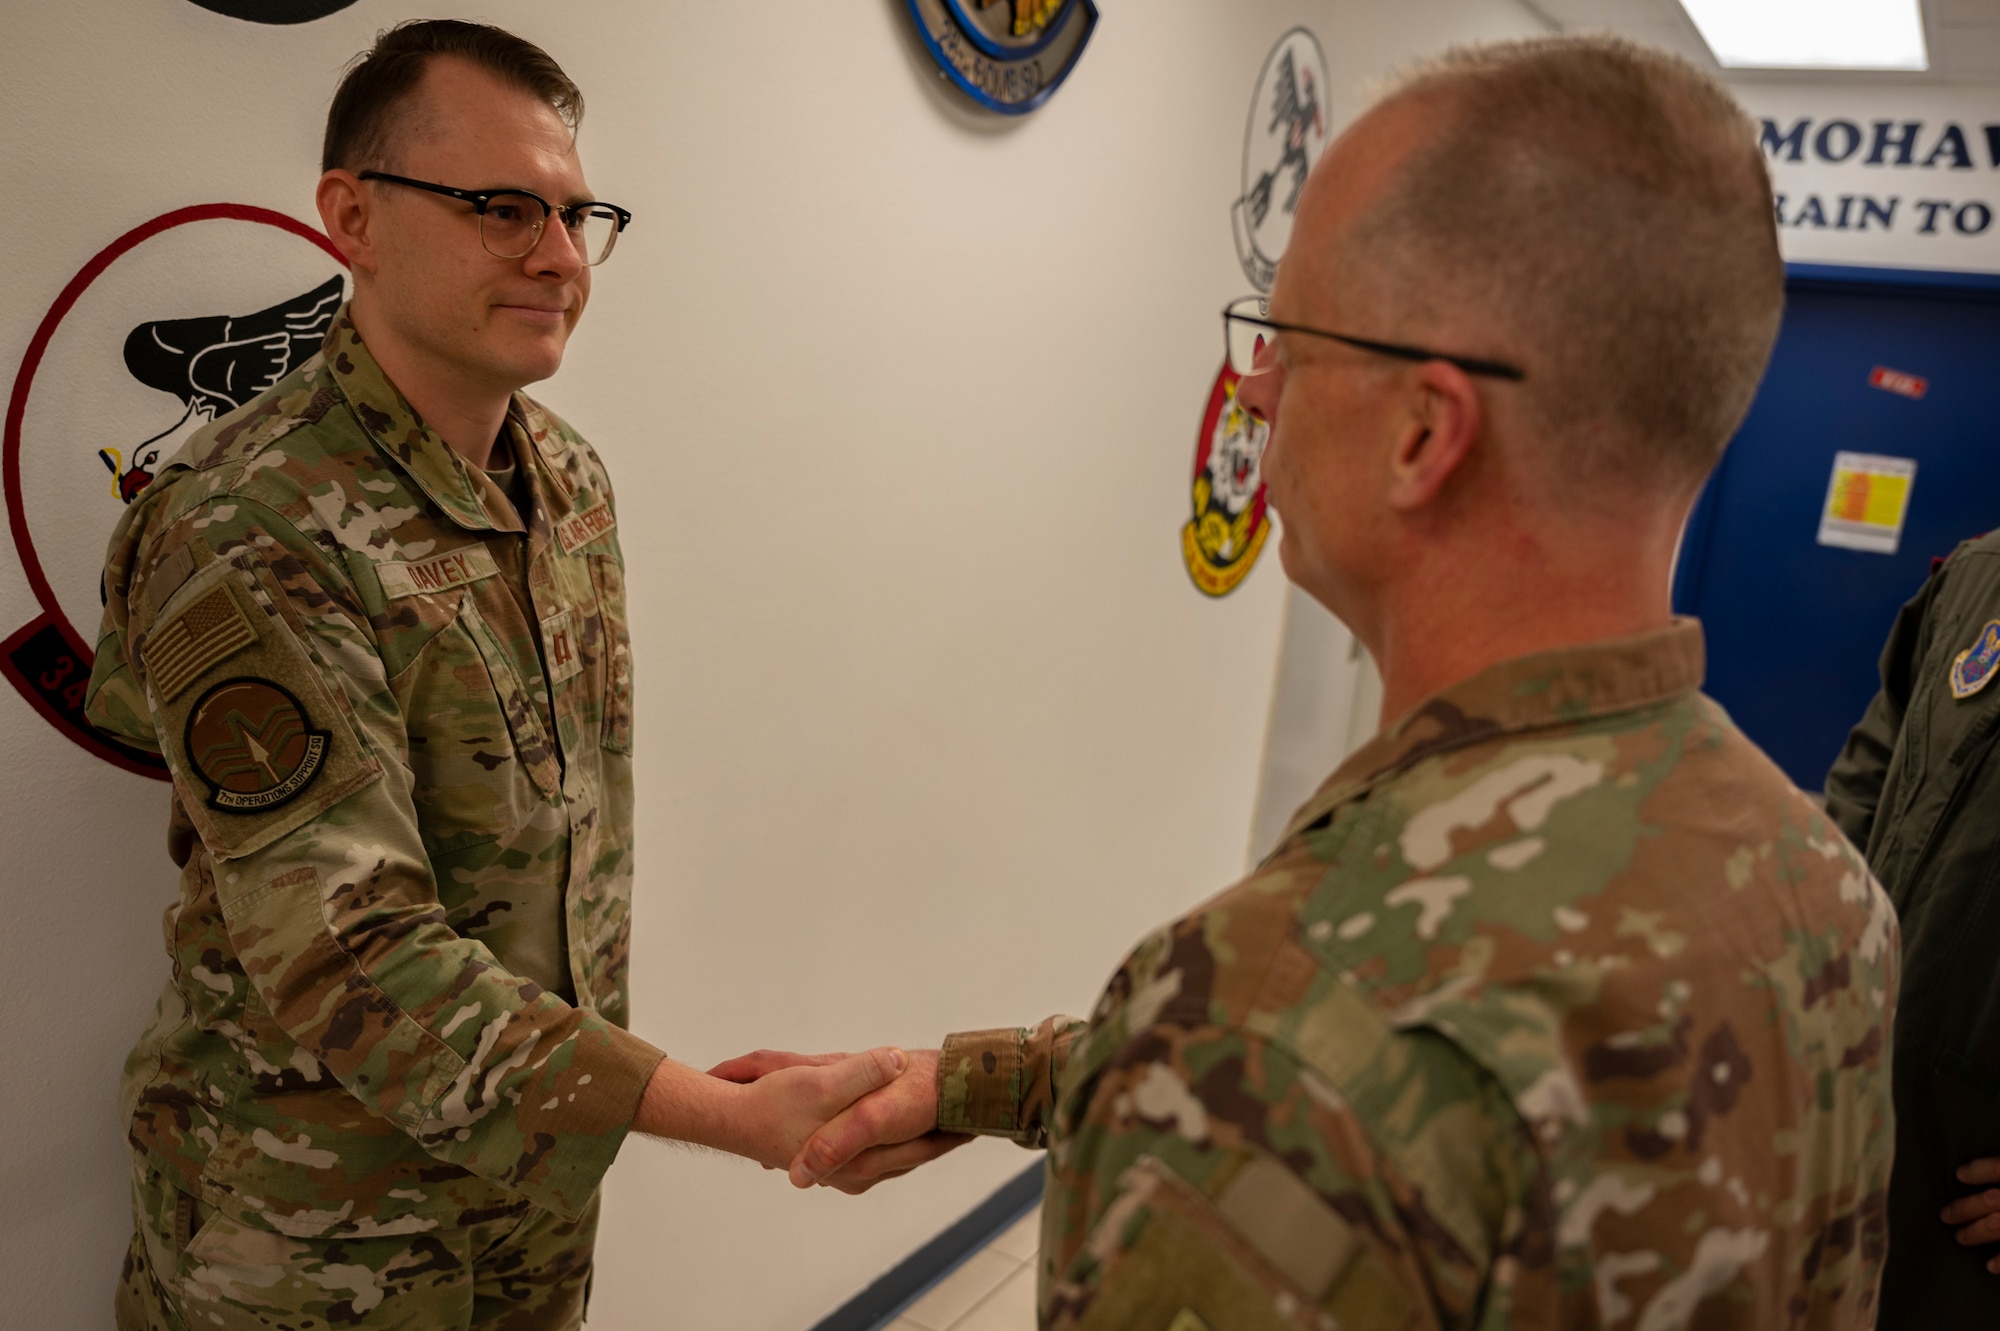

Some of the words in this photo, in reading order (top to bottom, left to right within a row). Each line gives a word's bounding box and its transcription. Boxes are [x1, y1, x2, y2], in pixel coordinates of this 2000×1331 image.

[1917, 202, 1991, 234] TO
[567, 519, 591, 545] AIR
[580, 503, 614, 536] FORCE
[407, 553, 472, 590] DAVEY
[236, 783, 292, 806] OPERATIONS
[290, 751, 318, 787] SUPPORT
[311, 737, 323, 750] SQ
